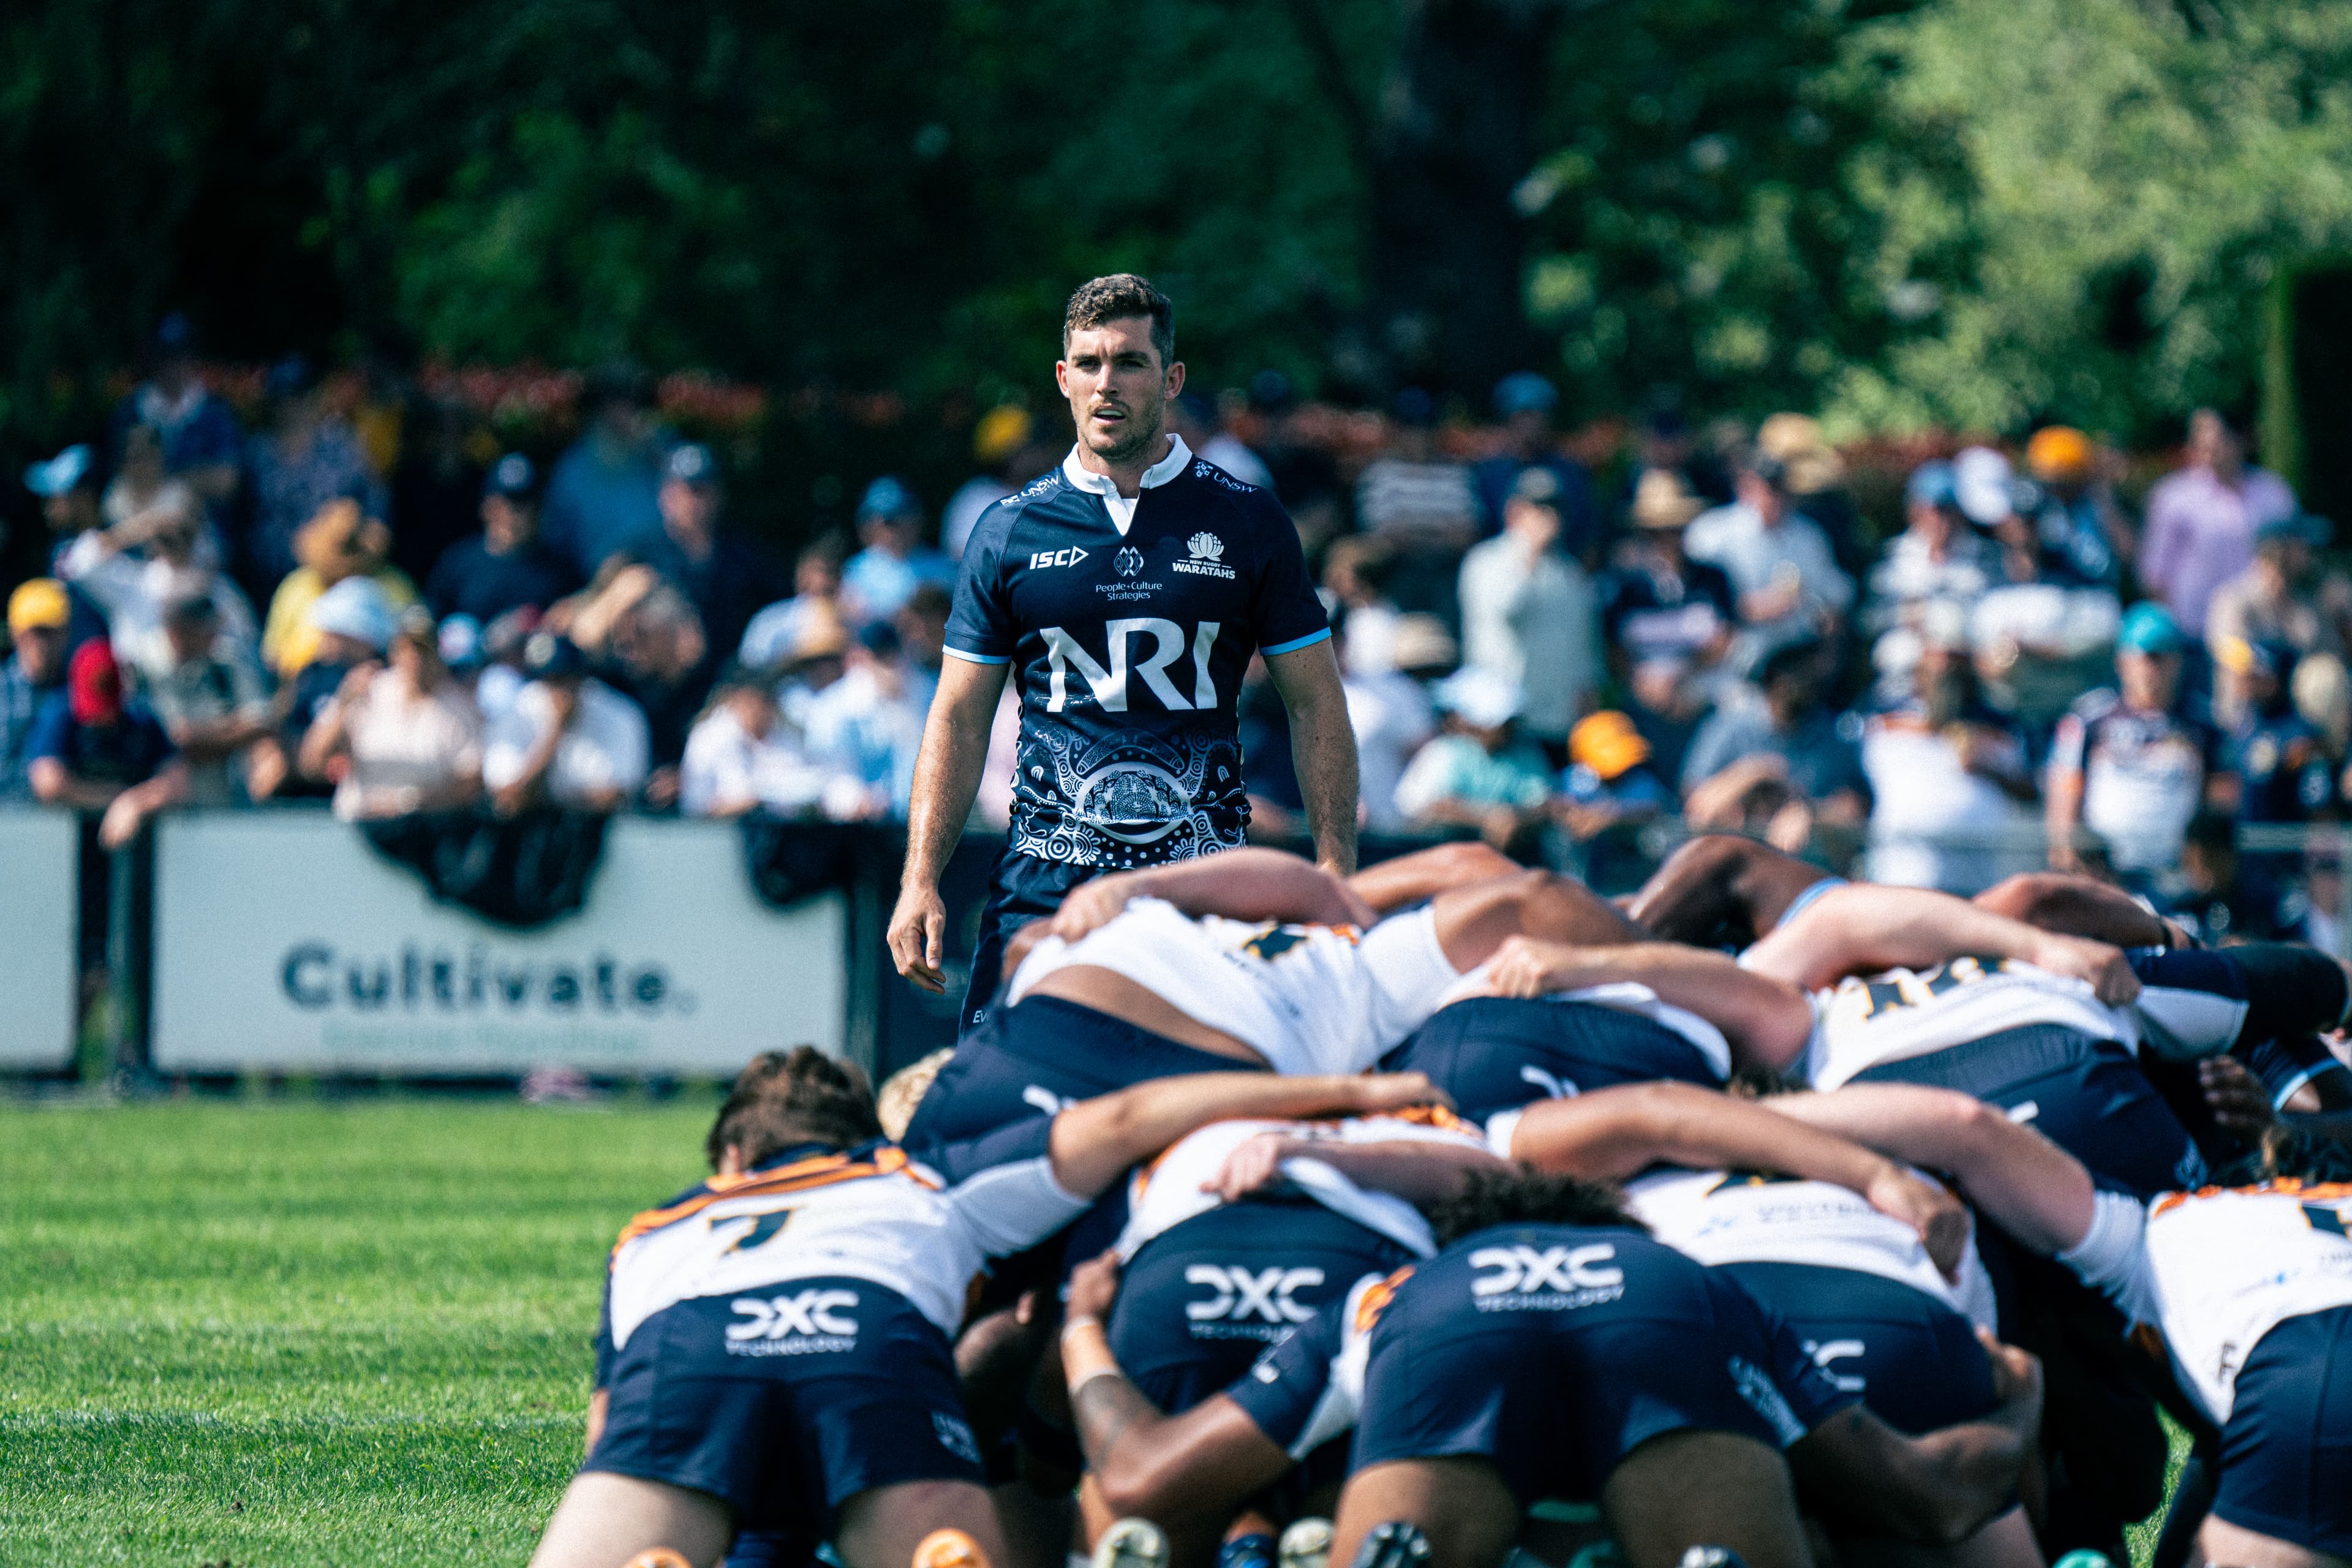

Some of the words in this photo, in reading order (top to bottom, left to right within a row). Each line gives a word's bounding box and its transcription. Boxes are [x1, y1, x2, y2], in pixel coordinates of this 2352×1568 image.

[1020, 475, 1058, 497] UNSW
[1213, 472, 1257, 492] UNSW
[1029, 549, 1071, 570] ISC
[1172, 562, 1235, 579] WARATAHS
[1107, 591, 1151, 601] Strategies
[1039, 617, 1220, 712] NRI
[1472, 1284, 1625, 1313] TECHNOLOGY
